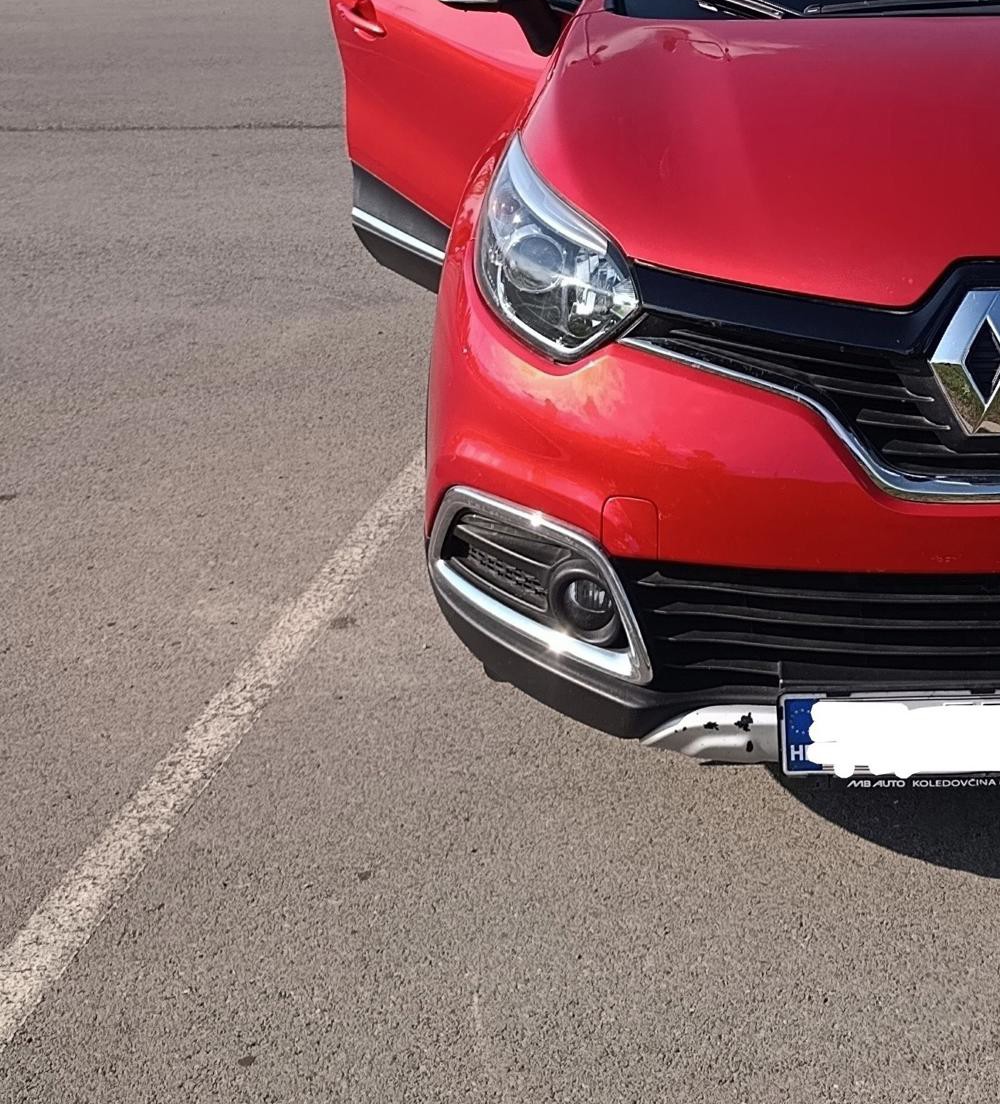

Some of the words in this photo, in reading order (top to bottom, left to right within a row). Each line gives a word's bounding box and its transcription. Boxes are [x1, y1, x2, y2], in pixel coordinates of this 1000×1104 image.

[790, 744, 810, 761] H
[847, 779, 871, 788] MB
[872, 779, 906, 788] AUTO
[912, 778, 997, 788] KOLEDOVČINA
